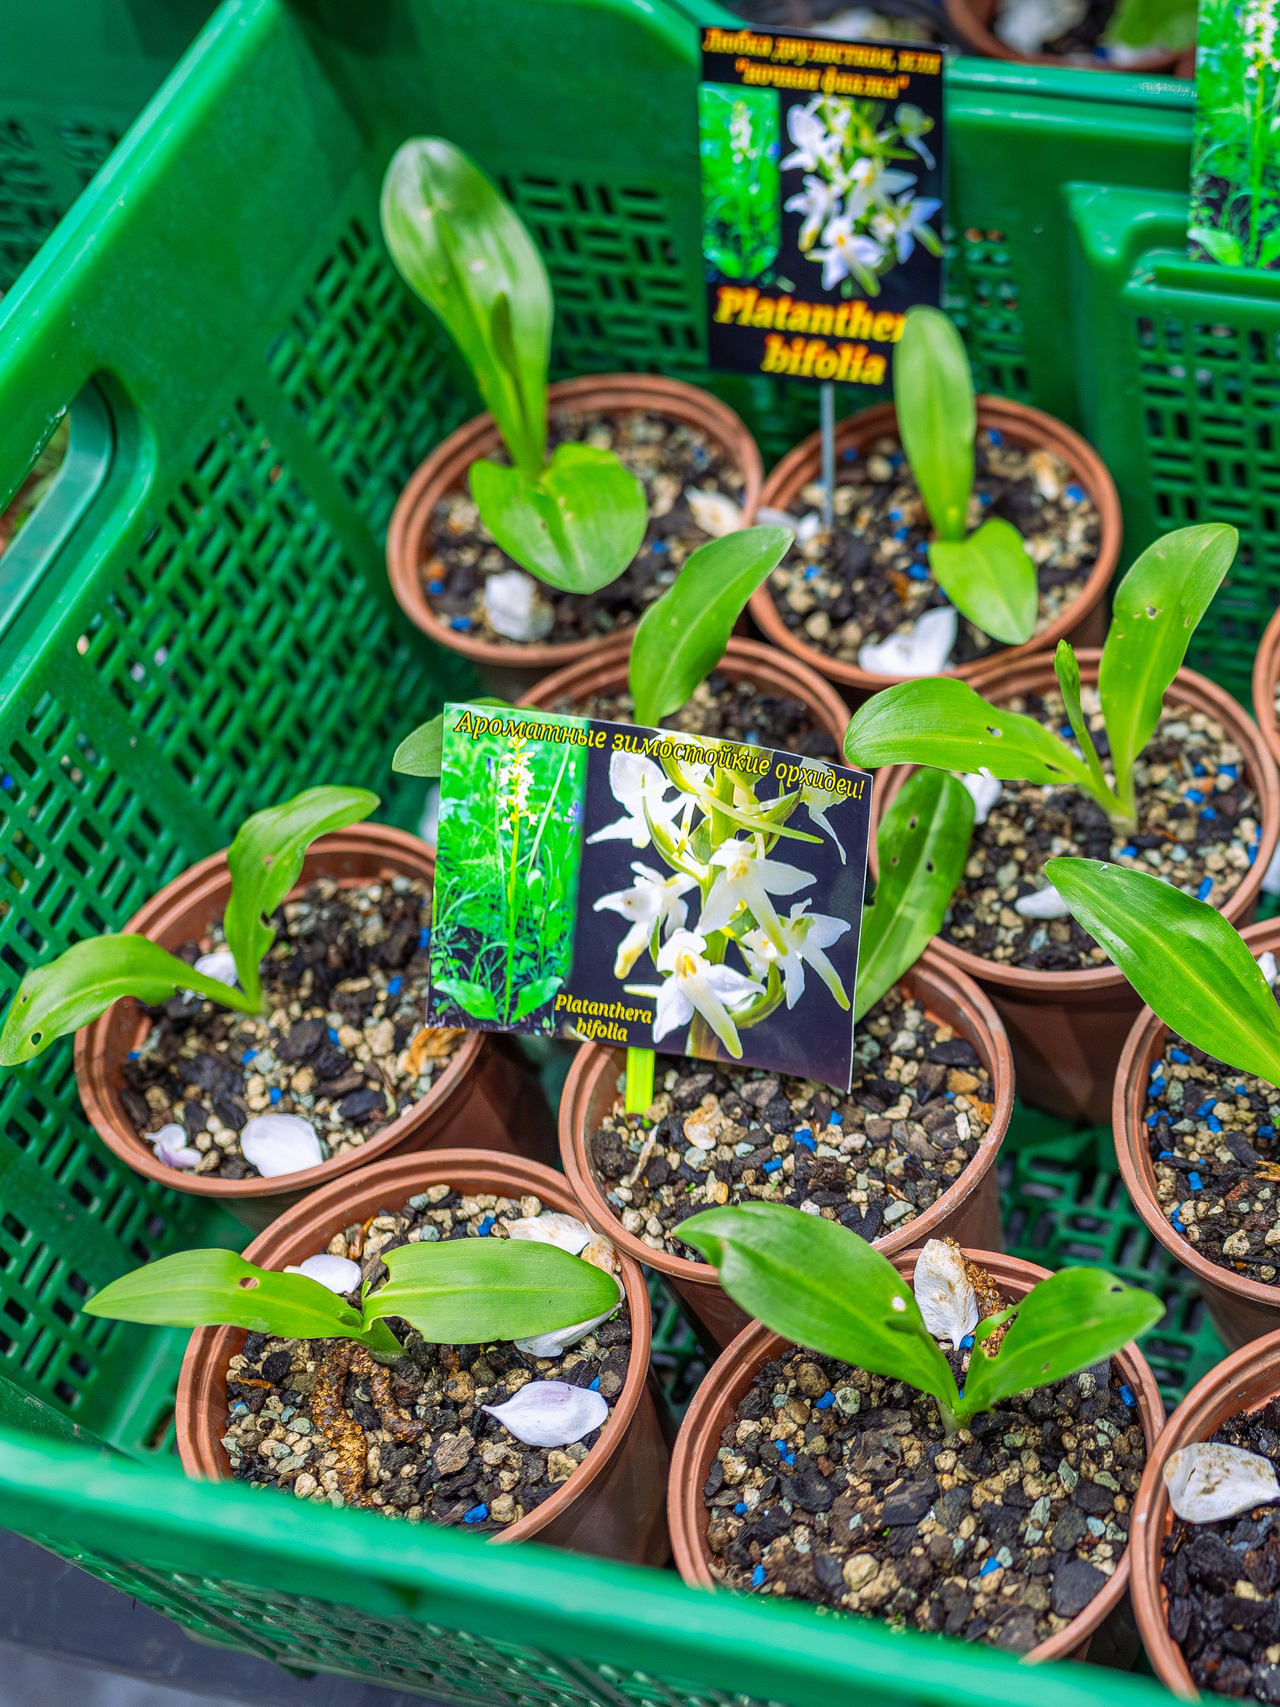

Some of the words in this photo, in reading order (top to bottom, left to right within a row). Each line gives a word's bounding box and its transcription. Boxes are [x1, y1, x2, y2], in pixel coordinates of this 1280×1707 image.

[713, 285, 907, 343] Platanther
[760, 333, 887, 385] bifolia
[453, 711, 606, 748] Ароматные
[611, 733, 771, 777] зимостойкие
[774, 761, 867, 801] орхидеи!
[554, 993, 652, 1024] Platanthera
[575, 1017, 628, 1042] bifolia
